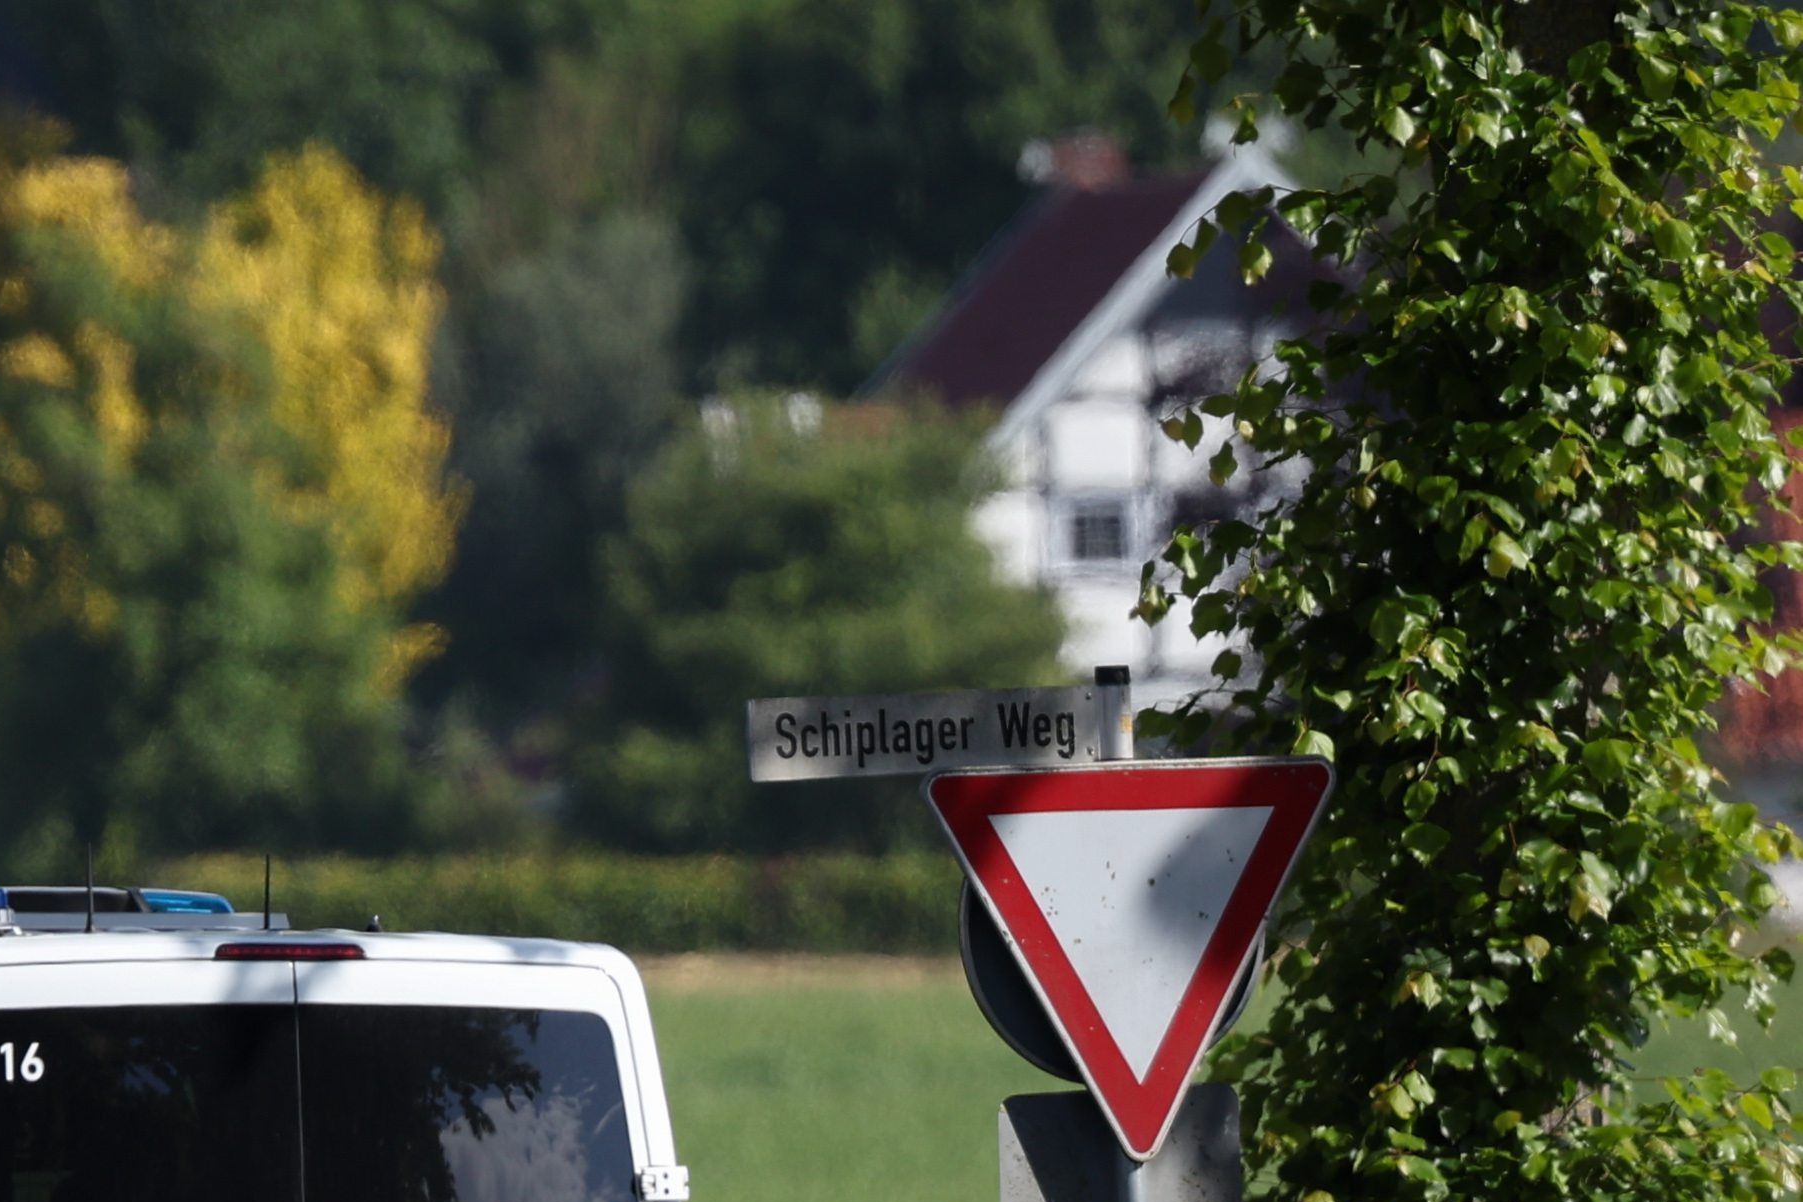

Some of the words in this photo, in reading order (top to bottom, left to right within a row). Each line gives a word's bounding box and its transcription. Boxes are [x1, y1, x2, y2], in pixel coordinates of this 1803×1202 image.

[775, 708, 975, 768] Schiplager
[998, 702, 1075, 759] Weg
[0, 1042, 45, 1081] 16
